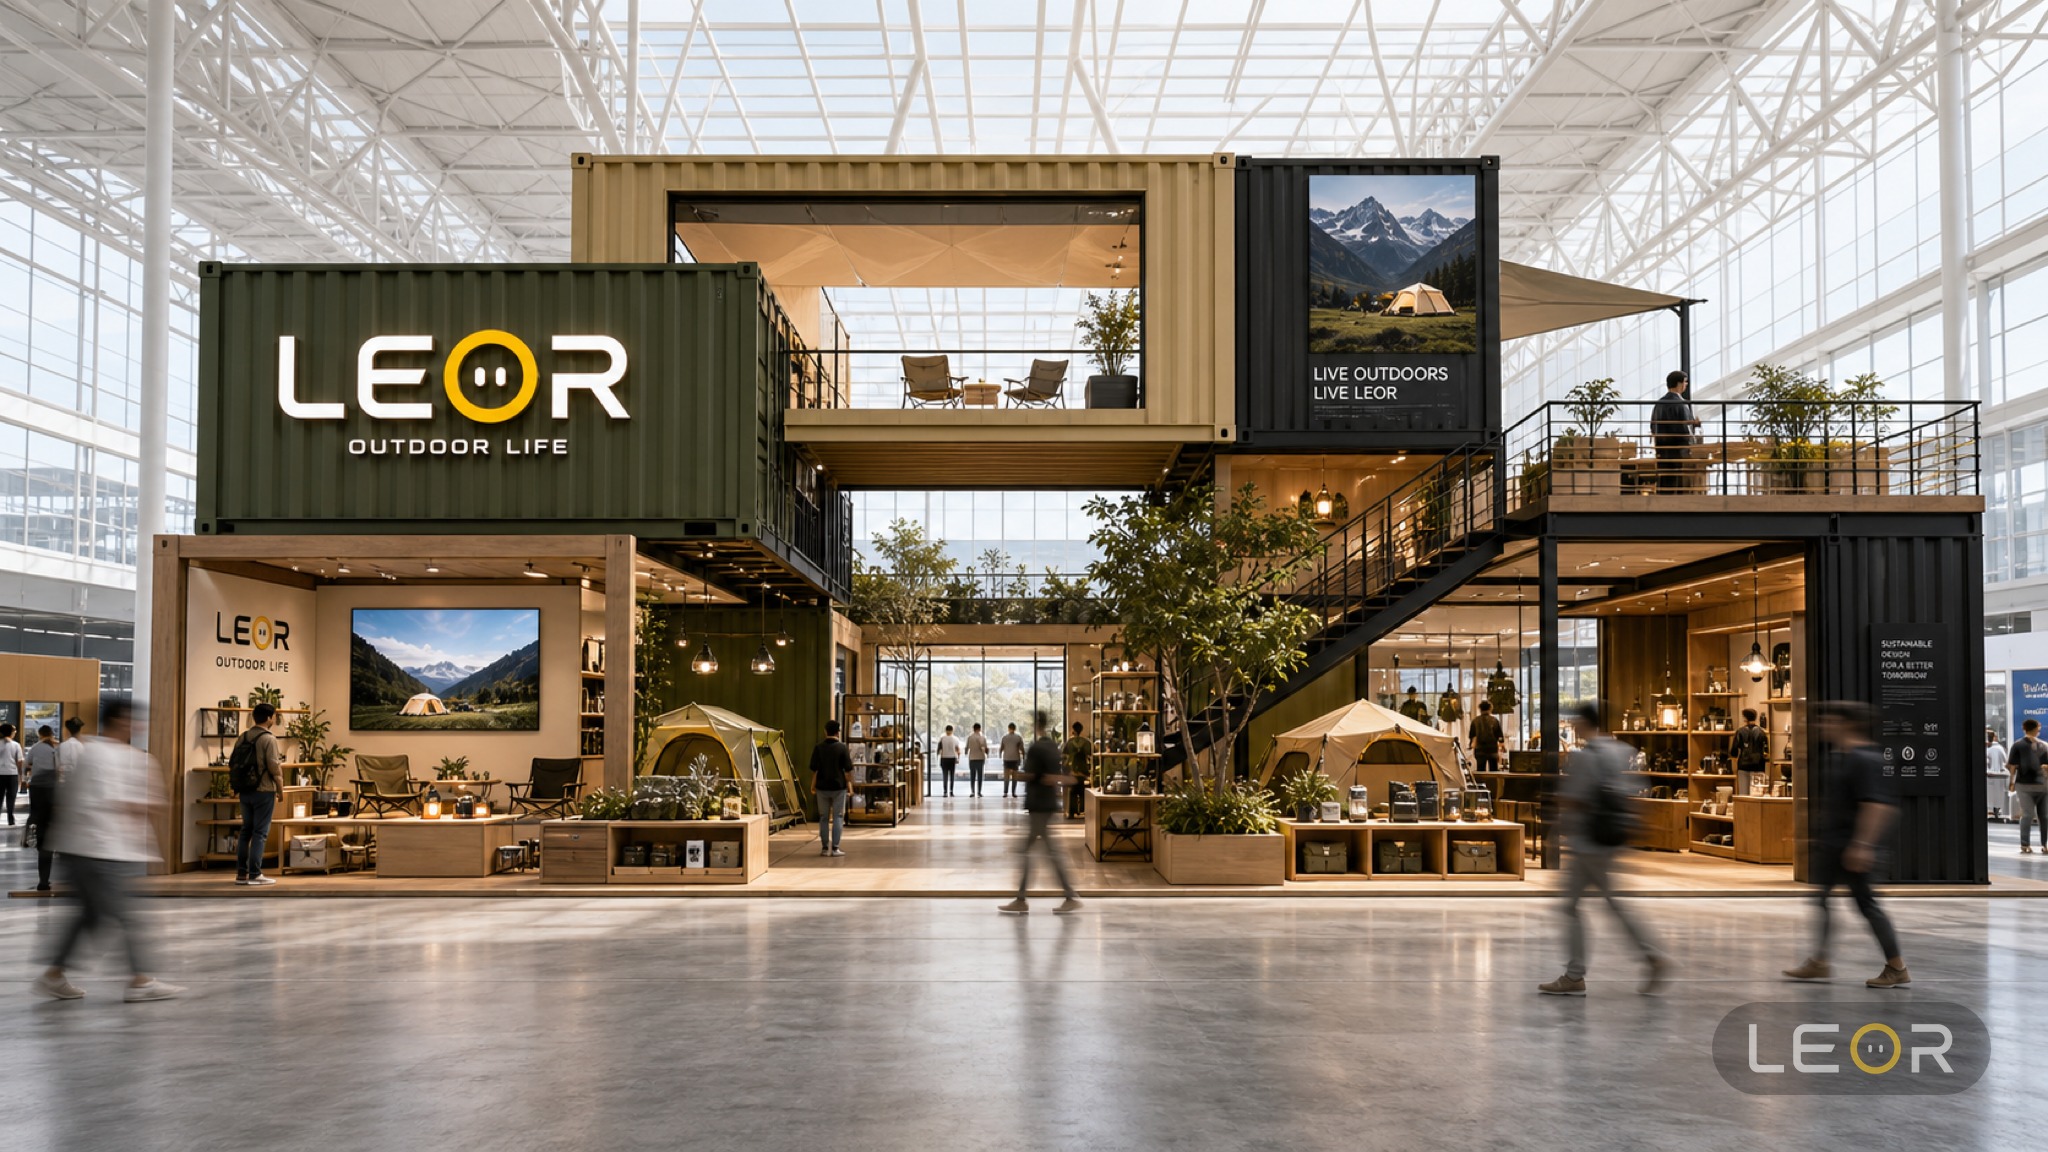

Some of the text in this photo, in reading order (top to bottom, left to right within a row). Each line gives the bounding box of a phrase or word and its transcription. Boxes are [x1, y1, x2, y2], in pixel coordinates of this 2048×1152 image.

[278, 329, 631, 423] LEOR
[1314, 366, 1448, 381] LIVE OUTDOORS
[1314, 386, 1397, 400] LIVE LEOR
[348, 438, 569, 455] OUTDOOR LIFE
[216, 611, 290, 651] LEOR
[216, 656, 289, 673] OUTDOOR LIFE
